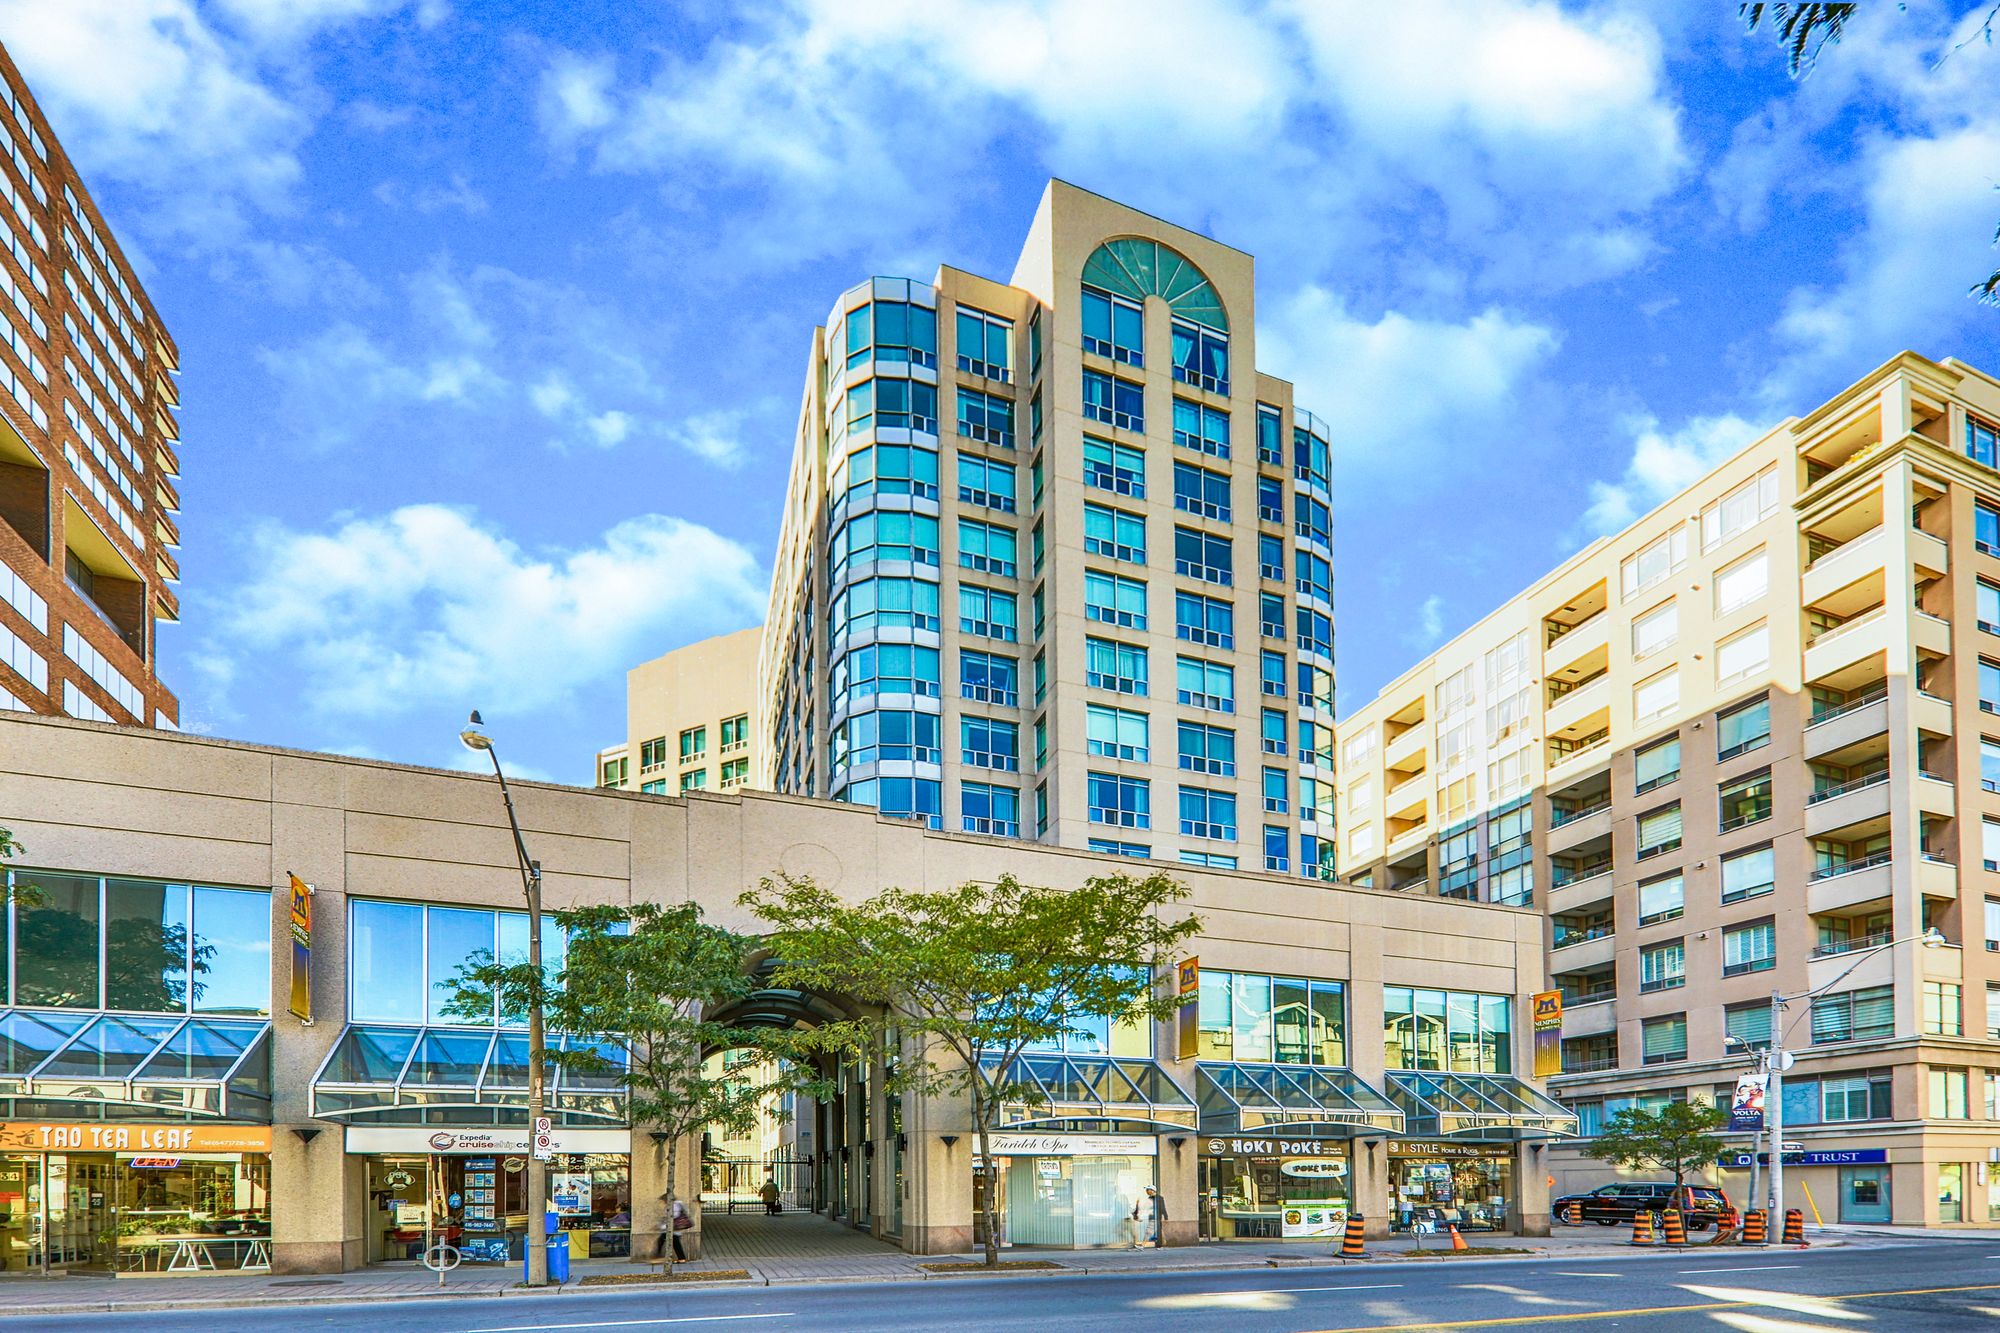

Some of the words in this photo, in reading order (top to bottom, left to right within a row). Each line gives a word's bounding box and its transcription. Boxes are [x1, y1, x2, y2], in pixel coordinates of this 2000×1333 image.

[39, 1126, 82, 1147] TAO
[90, 1127, 129, 1148] TEA
[141, 1128, 193, 1149] LEAF
[989, 1136, 1037, 1149] Farideh
[1042, 1137, 1069, 1152] Spa
[1231, 1140, 1273, 1153] HOKI
[1410, 1144, 1438, 1153] STYLE
[134, 1157, 176, 1166] OPEN
[1811, 1152, 1860, 1161] TRUST
